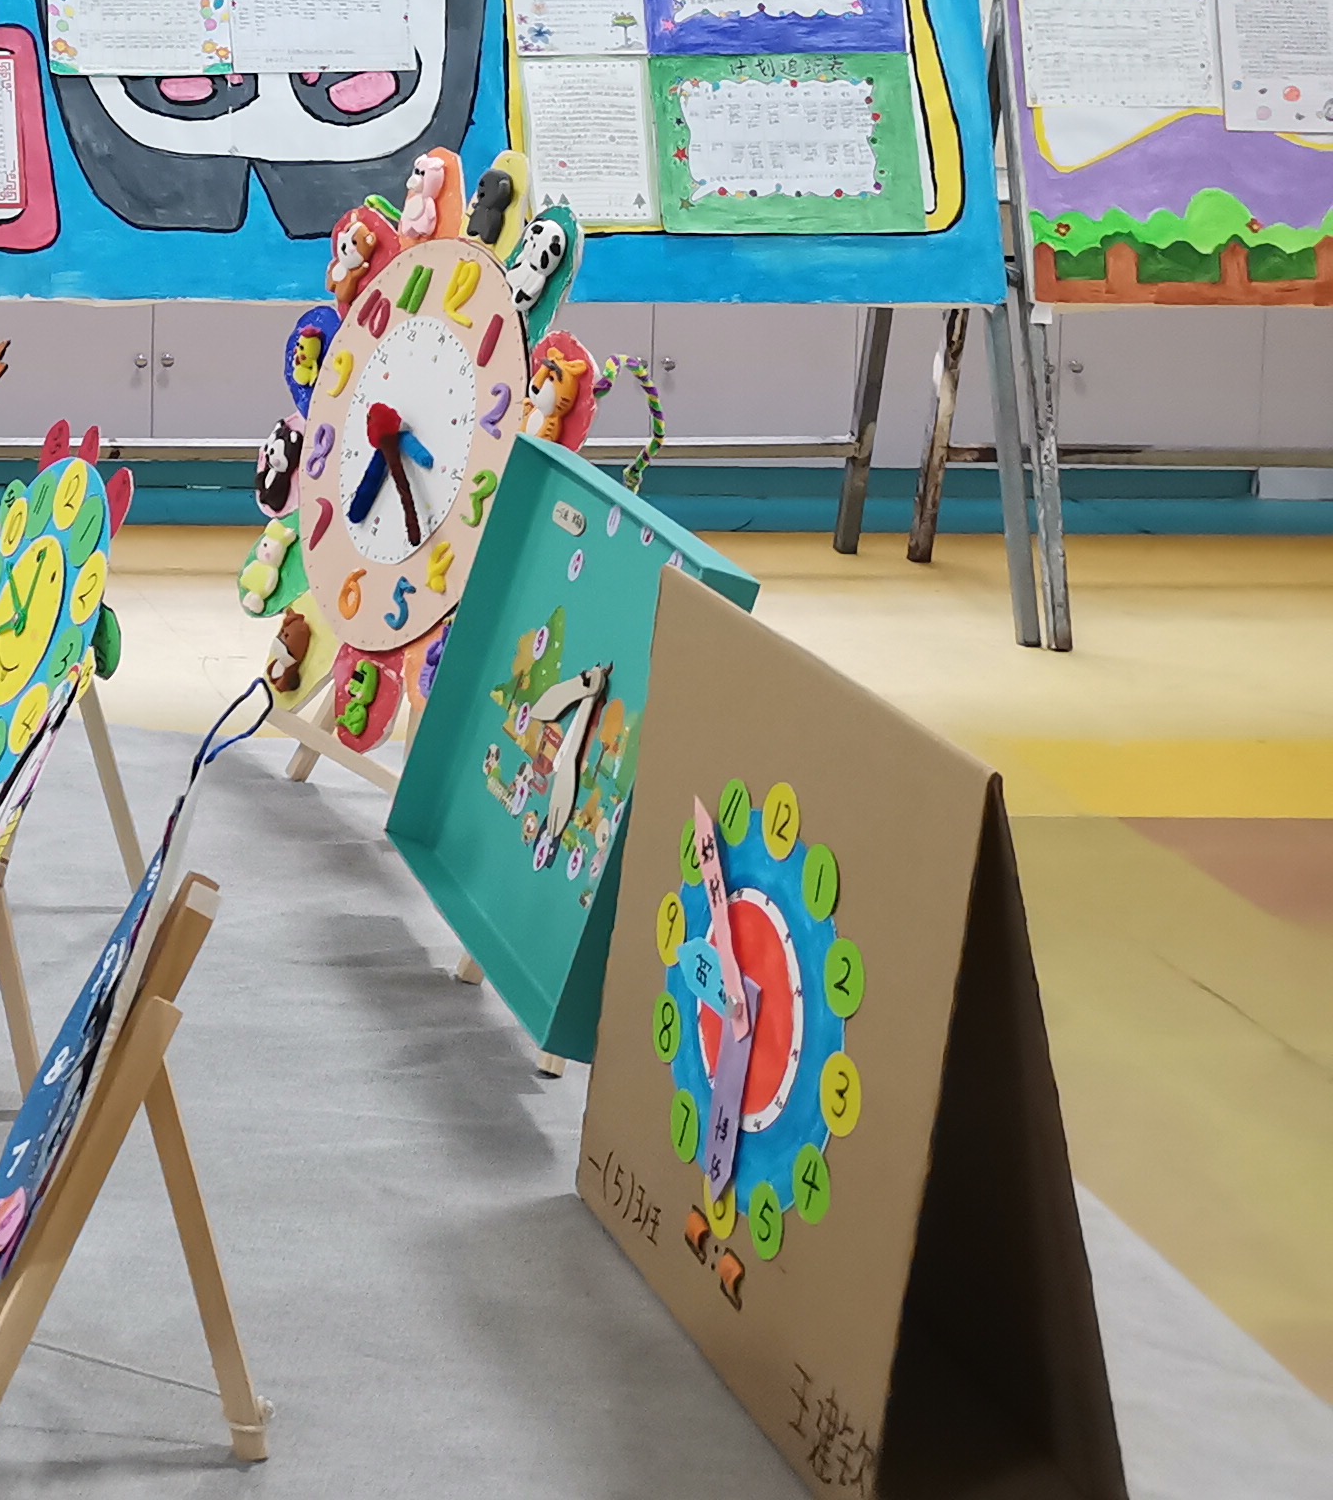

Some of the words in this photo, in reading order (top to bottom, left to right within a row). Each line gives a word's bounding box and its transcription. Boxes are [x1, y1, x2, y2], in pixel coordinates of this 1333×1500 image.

[357, 288, 391, 339] 10
[397, 264, 434, 314] 11
[443, 259, 482, 328] 12
[477, 313, 504, 368] 1
[327, 349, 355, 398] 9
[480, 383, 511, 438] 2
[305, 423, 336, 479] 8
[460, 470, 497, 527] 3
[78, 573, 97, 610] 2
[338, 569, 367, 620] 6
[384, 576, 417, 630] 5
[722, 788, 744, 829] 11
[771, 803, 793, 842] 12
[813, 862, 824, 904] 1
[664, 901, 679, 950] 9
[834, 956, 852, 997] 2
[658, 1000, 675, 1037] 8
[831, 1071, 850, 1118] 3
[676, 1100, 692, 1148] 7
[801, 1160, 821, 1211] 4
[756, 1198, 774, 1243] 5
